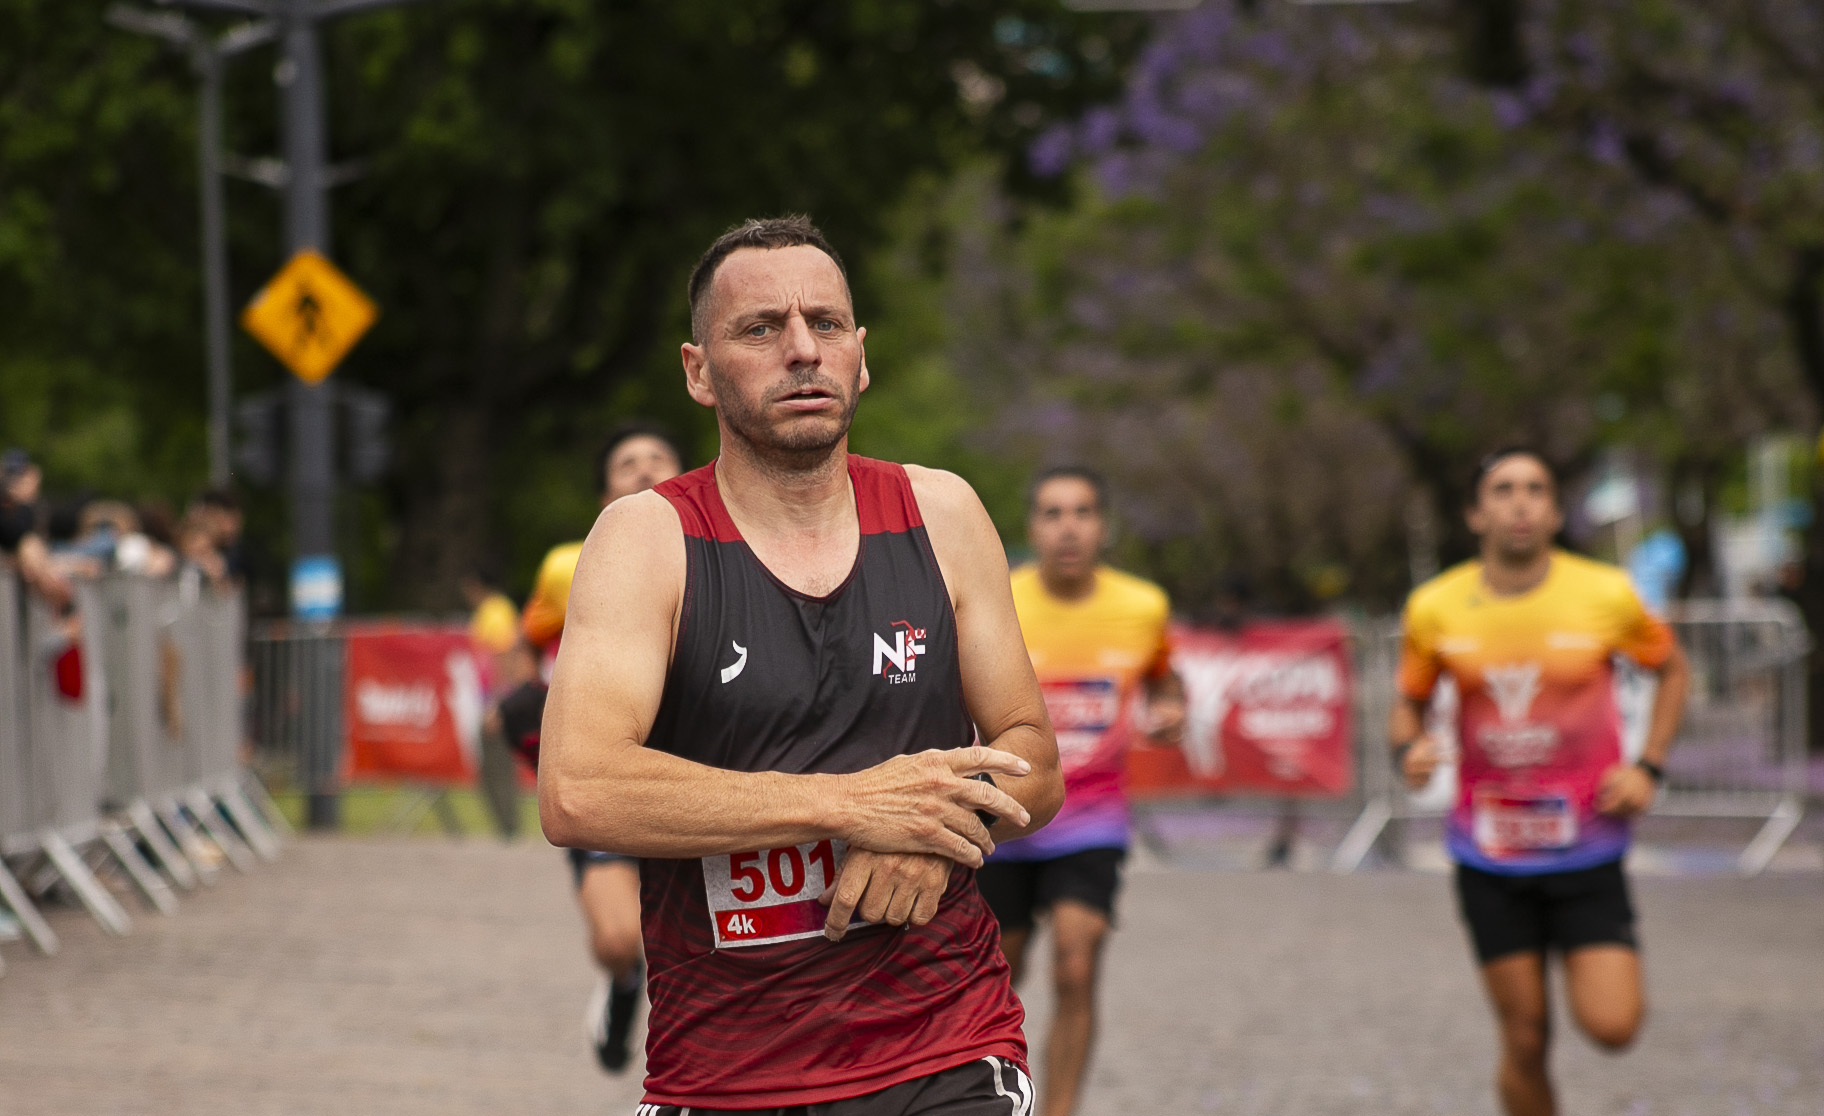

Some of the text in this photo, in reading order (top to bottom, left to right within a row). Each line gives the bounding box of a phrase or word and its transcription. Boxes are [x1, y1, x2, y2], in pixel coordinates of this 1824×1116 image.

[873, 629, 927, 675] NF
[888, 672, 916, 685] TEAM
[730, 838, 851, 903] 501
[727, 913, 756, 934] 4k
